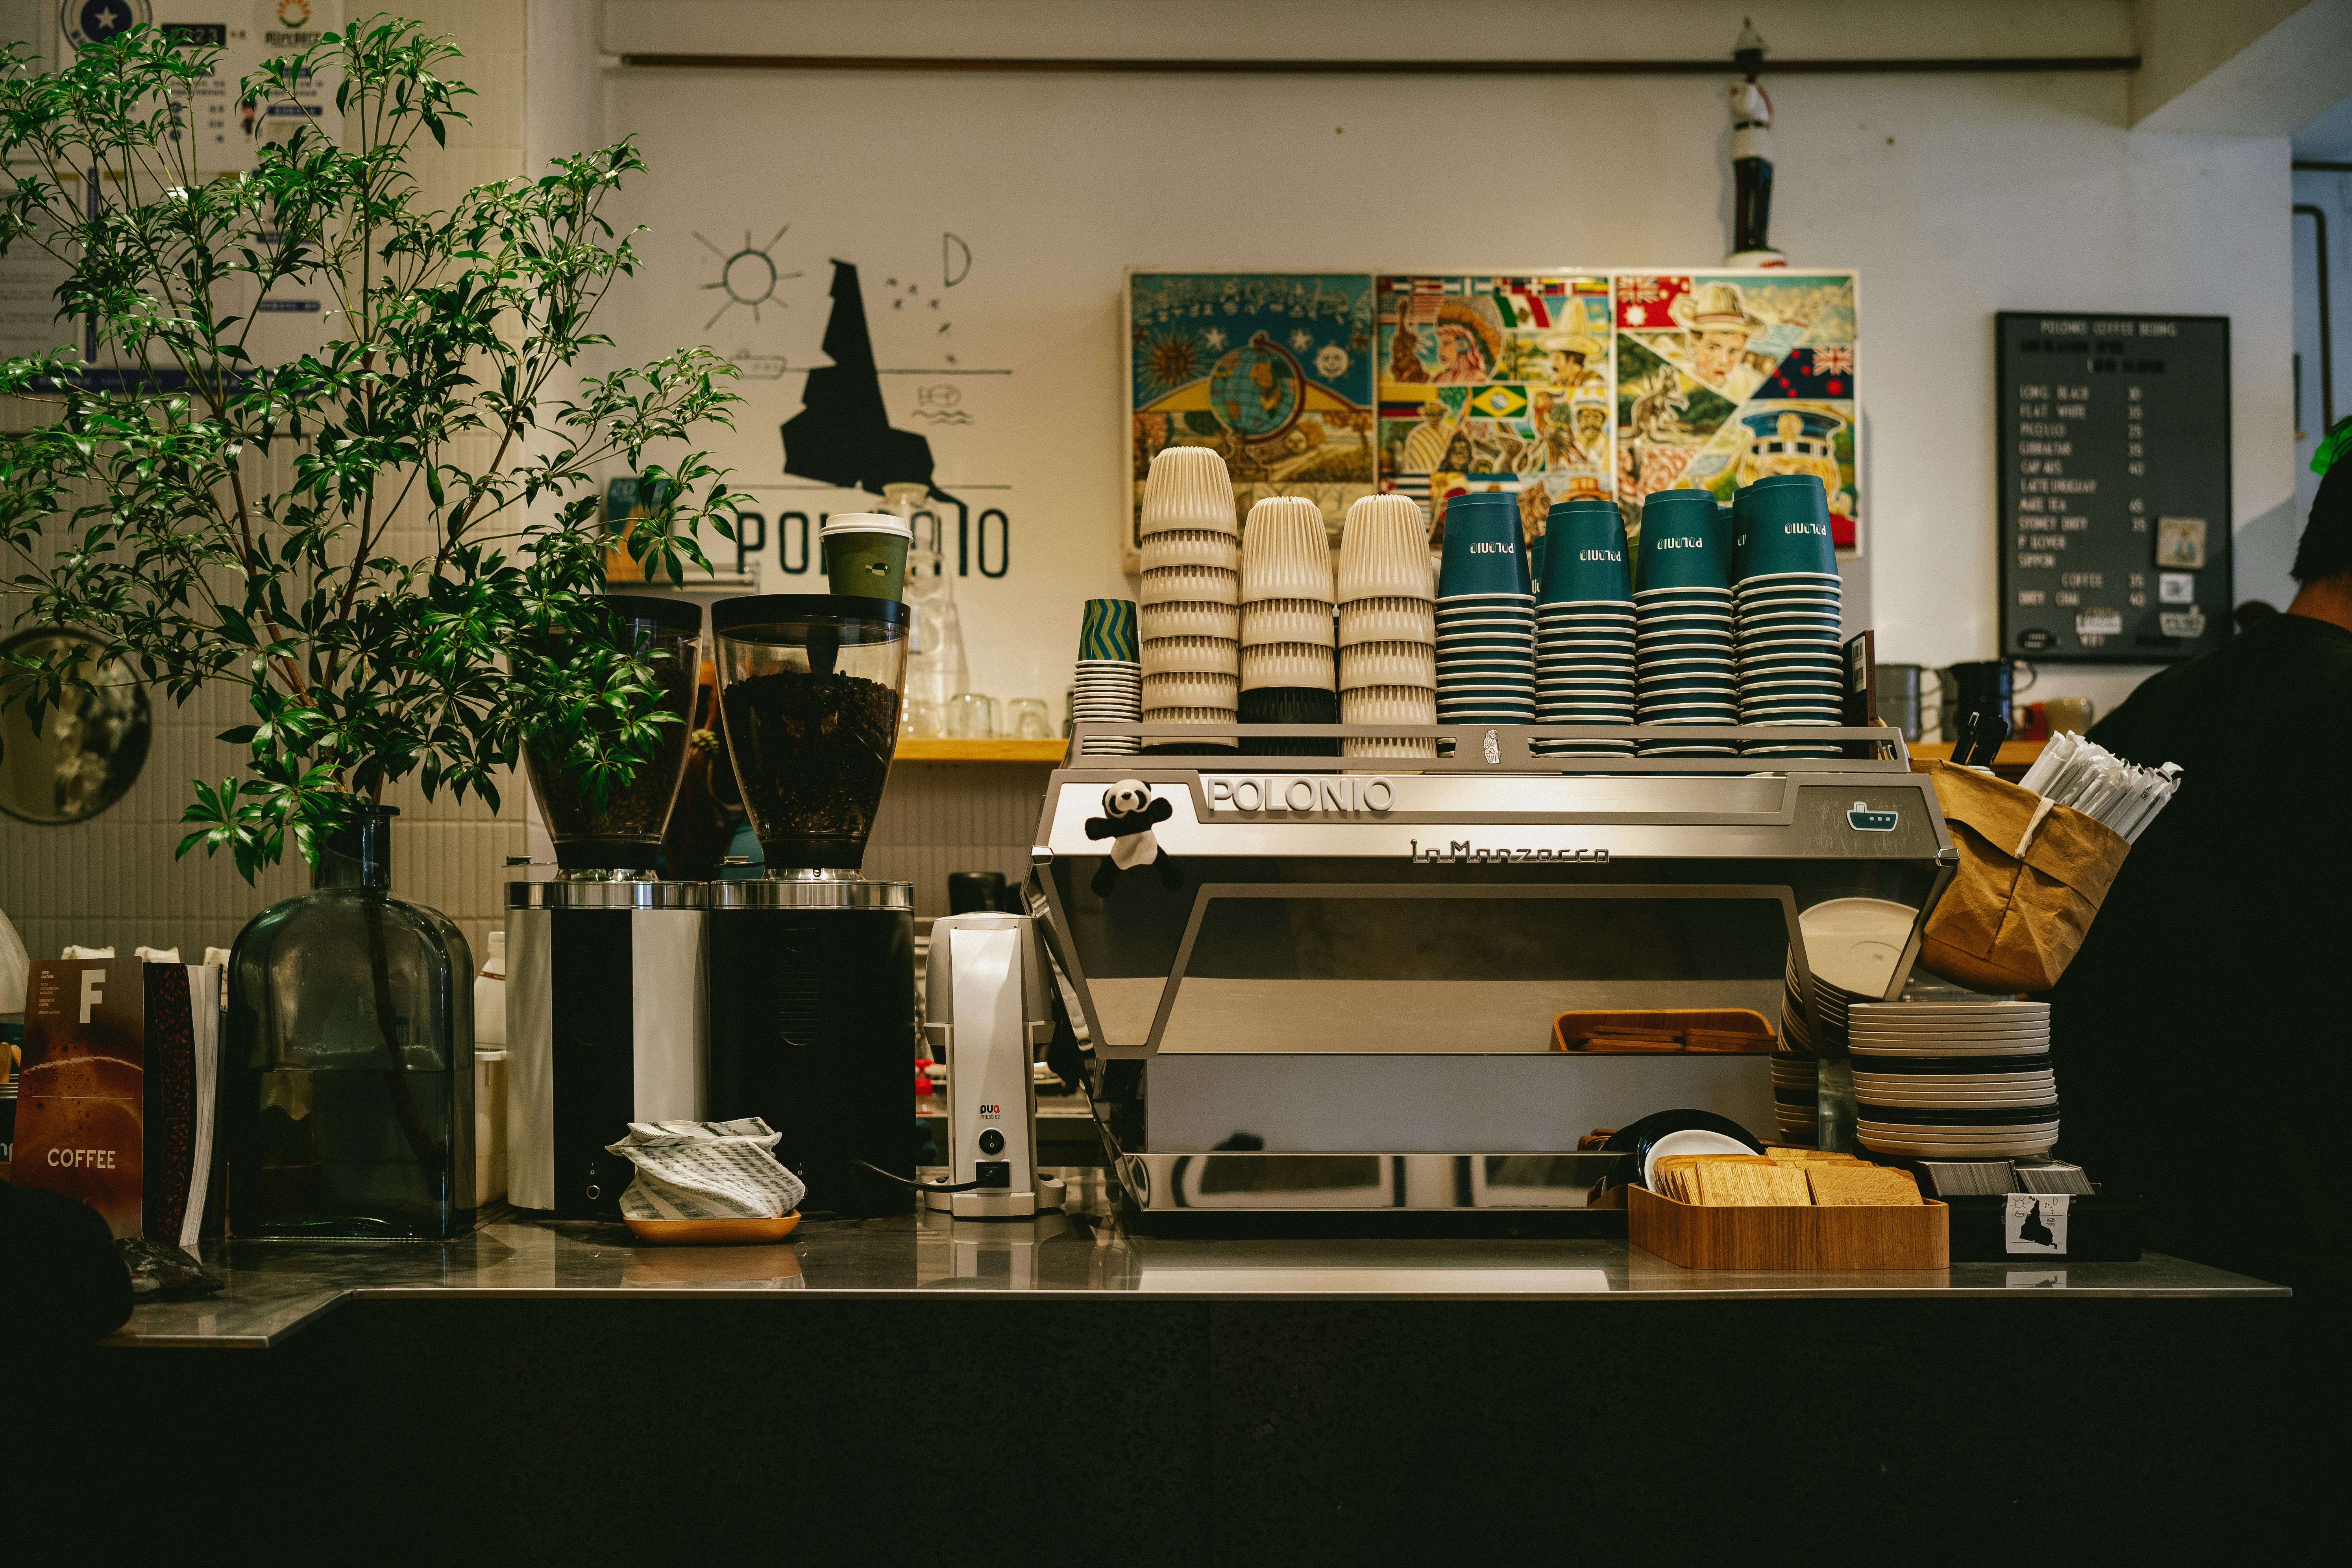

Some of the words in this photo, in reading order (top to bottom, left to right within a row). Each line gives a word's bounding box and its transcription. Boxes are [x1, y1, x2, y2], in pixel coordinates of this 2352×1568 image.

[2093, 321, 2134, 336] COFFEE
[2020, 385, 2049, 400] LONG
[2057, 385, 2089, 400] BLACK
[2020, 403, 2048, 418] FLAT
[2056, 404, 2086, 419] WHITE
[2048, 497, 2066, 512] TEA
[1784, 523, 1827, 536] POLONIO
[1470, 542, 1514, 554] POLONIO
[1657, 537, 1703, 550] POLONIO
[1579, 550, 1621, 562] POLONIO
[2062, 572, 2102, 588] COFFEE
[1208, 777, 1396, 811] POLONIO
[80, 969, 106, 1023] F
[48, 1148, 116, 1169] COFFEE
